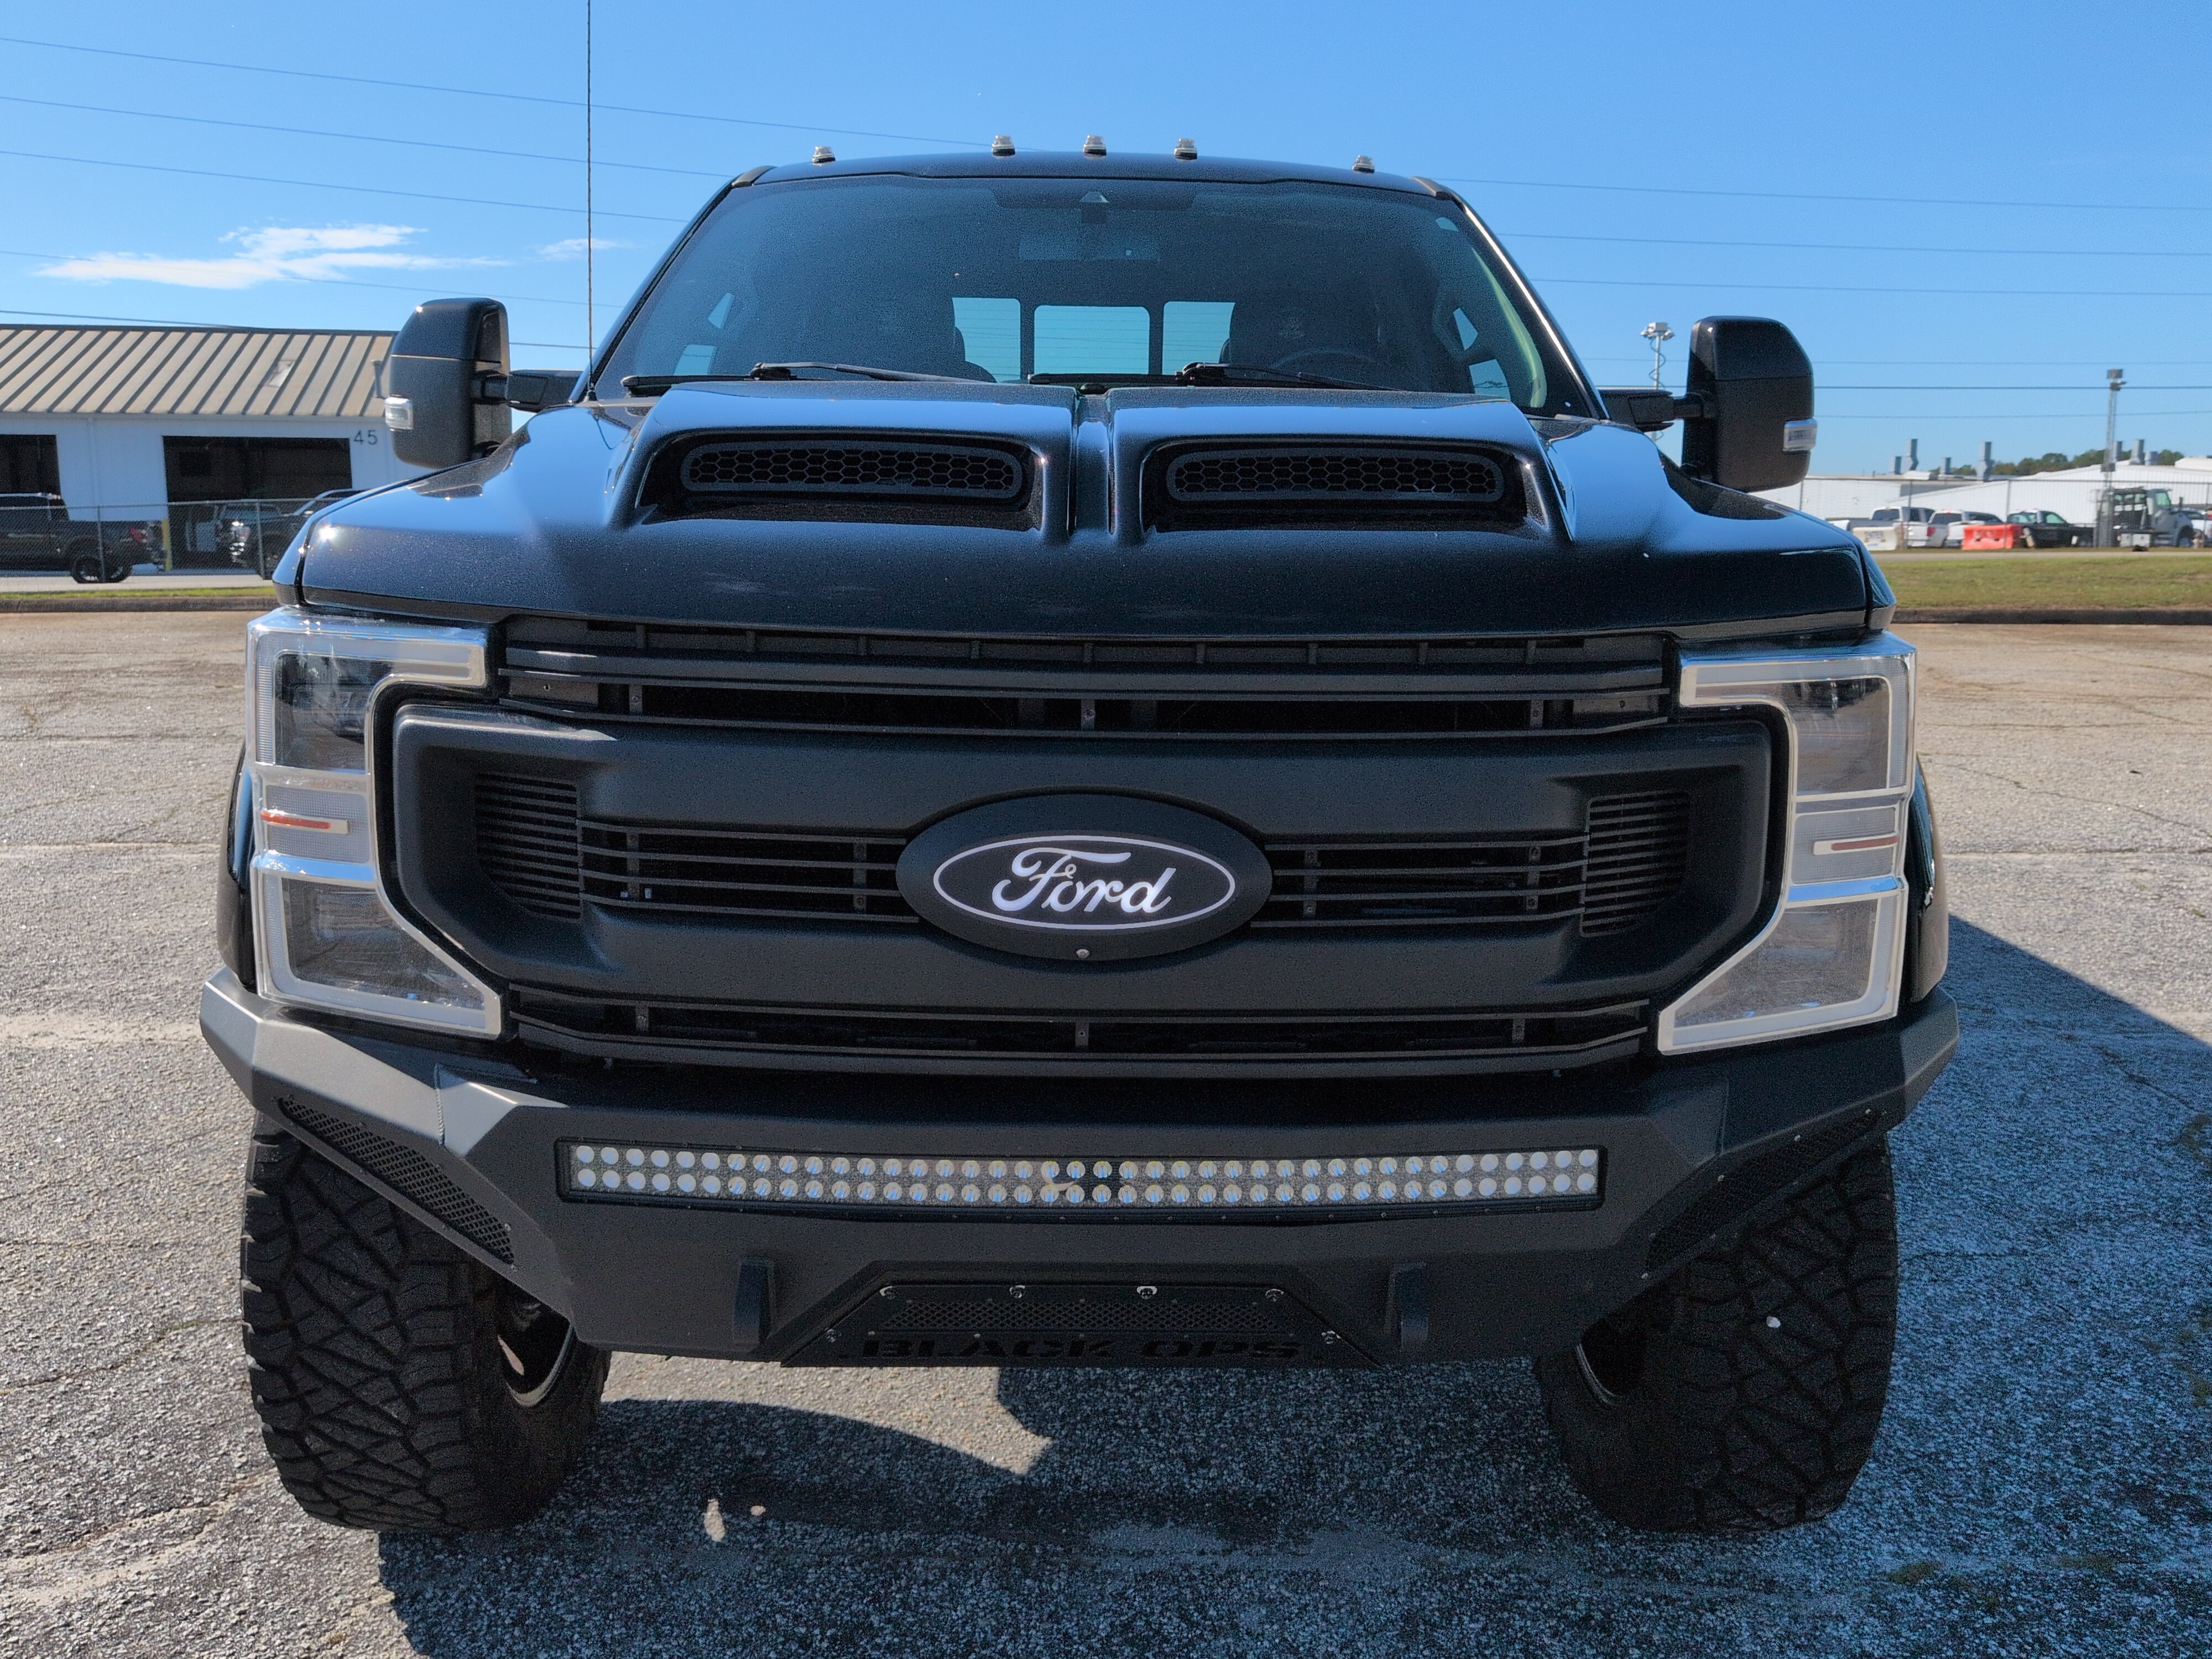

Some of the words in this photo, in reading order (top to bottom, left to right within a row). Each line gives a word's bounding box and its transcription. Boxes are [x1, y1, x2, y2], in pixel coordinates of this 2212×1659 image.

[354, 430, 378, 445] 45
[992, 847, 1176, 914] Ford
[862, 1339, 1116, 1357] BLACK
[1141, 1340, 1301, 1358] OPS
